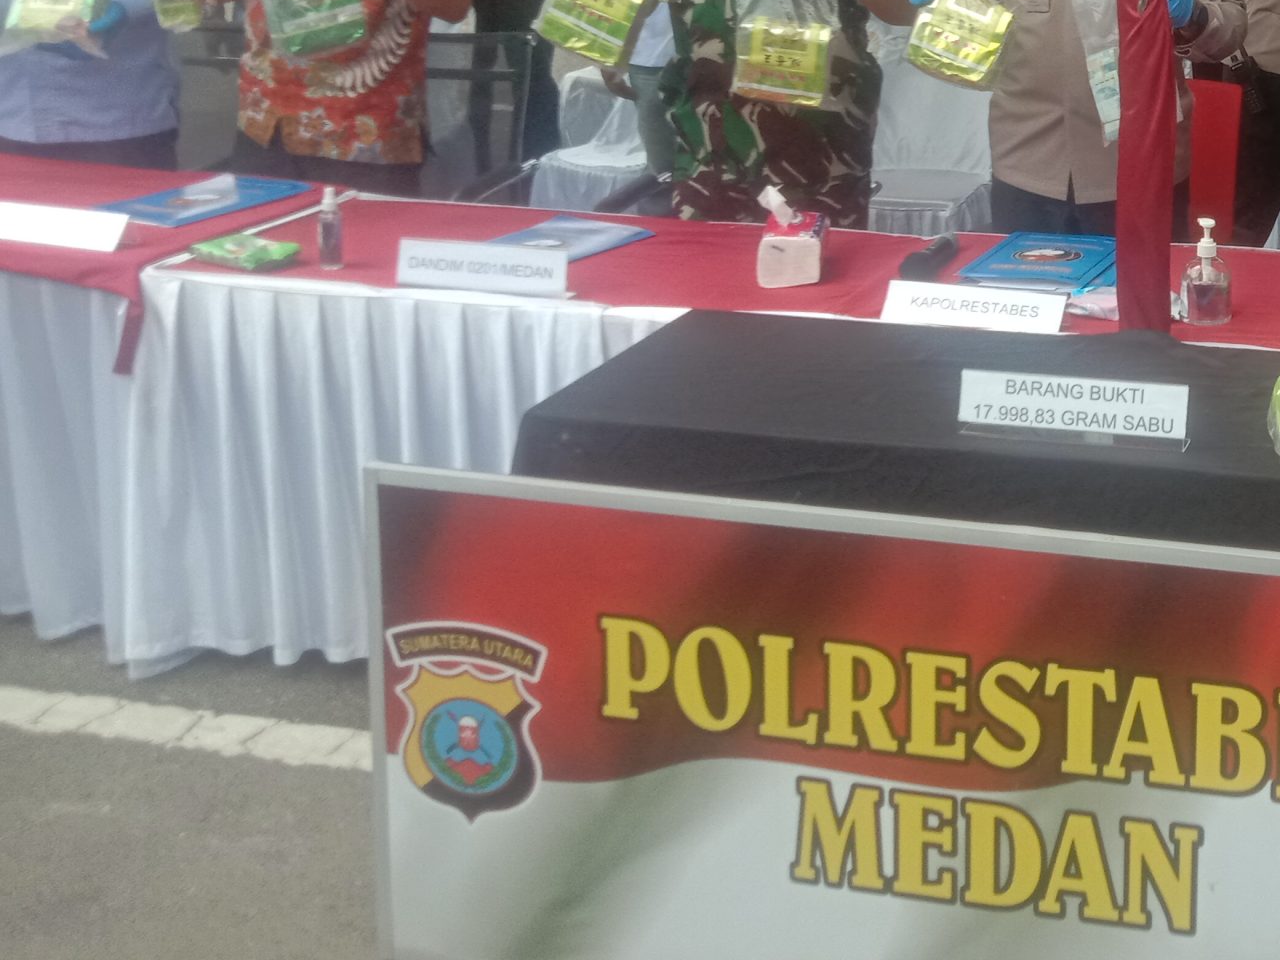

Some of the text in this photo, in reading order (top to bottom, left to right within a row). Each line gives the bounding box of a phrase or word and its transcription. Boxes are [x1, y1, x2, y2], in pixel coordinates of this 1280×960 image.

[408, 256, 463, 272] DANDIM
[909, 294, 1041, 319] KAPOLRESTABES
[1005, 378, 1146, 405] BARANG BUKTI
[973, 403, 1175, 435] 17.998,83 GRAM SABU
[399, 633, 535, 668] SUMATERA UTARA
[793, 778, 1202, 933] MEDAN
